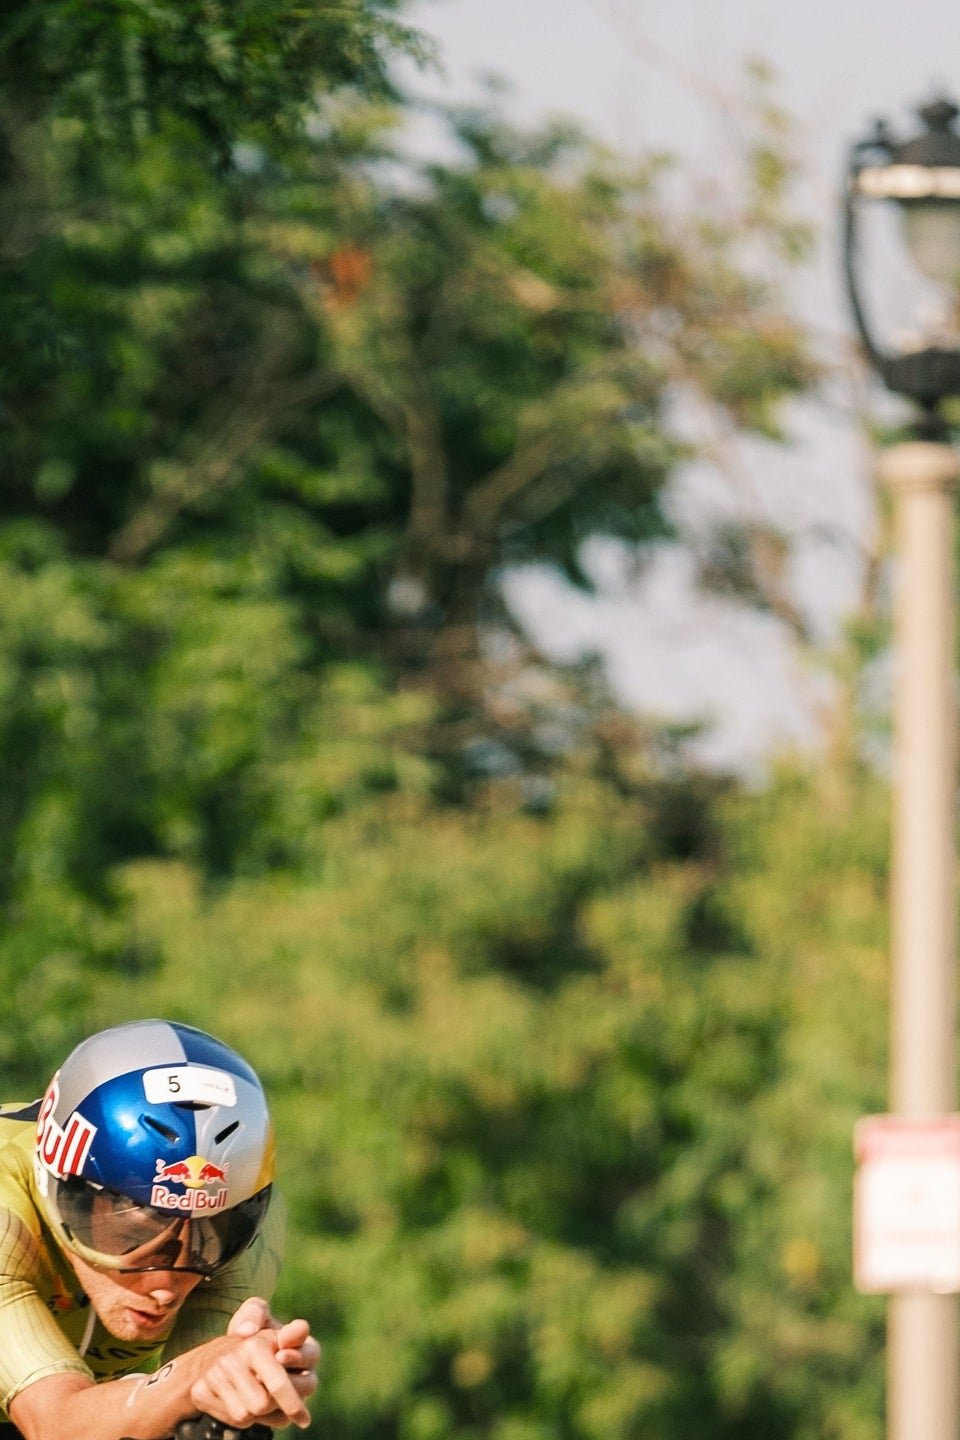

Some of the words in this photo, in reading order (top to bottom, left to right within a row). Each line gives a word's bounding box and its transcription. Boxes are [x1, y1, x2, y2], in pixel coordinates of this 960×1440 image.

[167, 1074, 181, 1093] 5
[152, 1186, 193, 1209] Red
[194, 1189, 228, 1209] Bull
